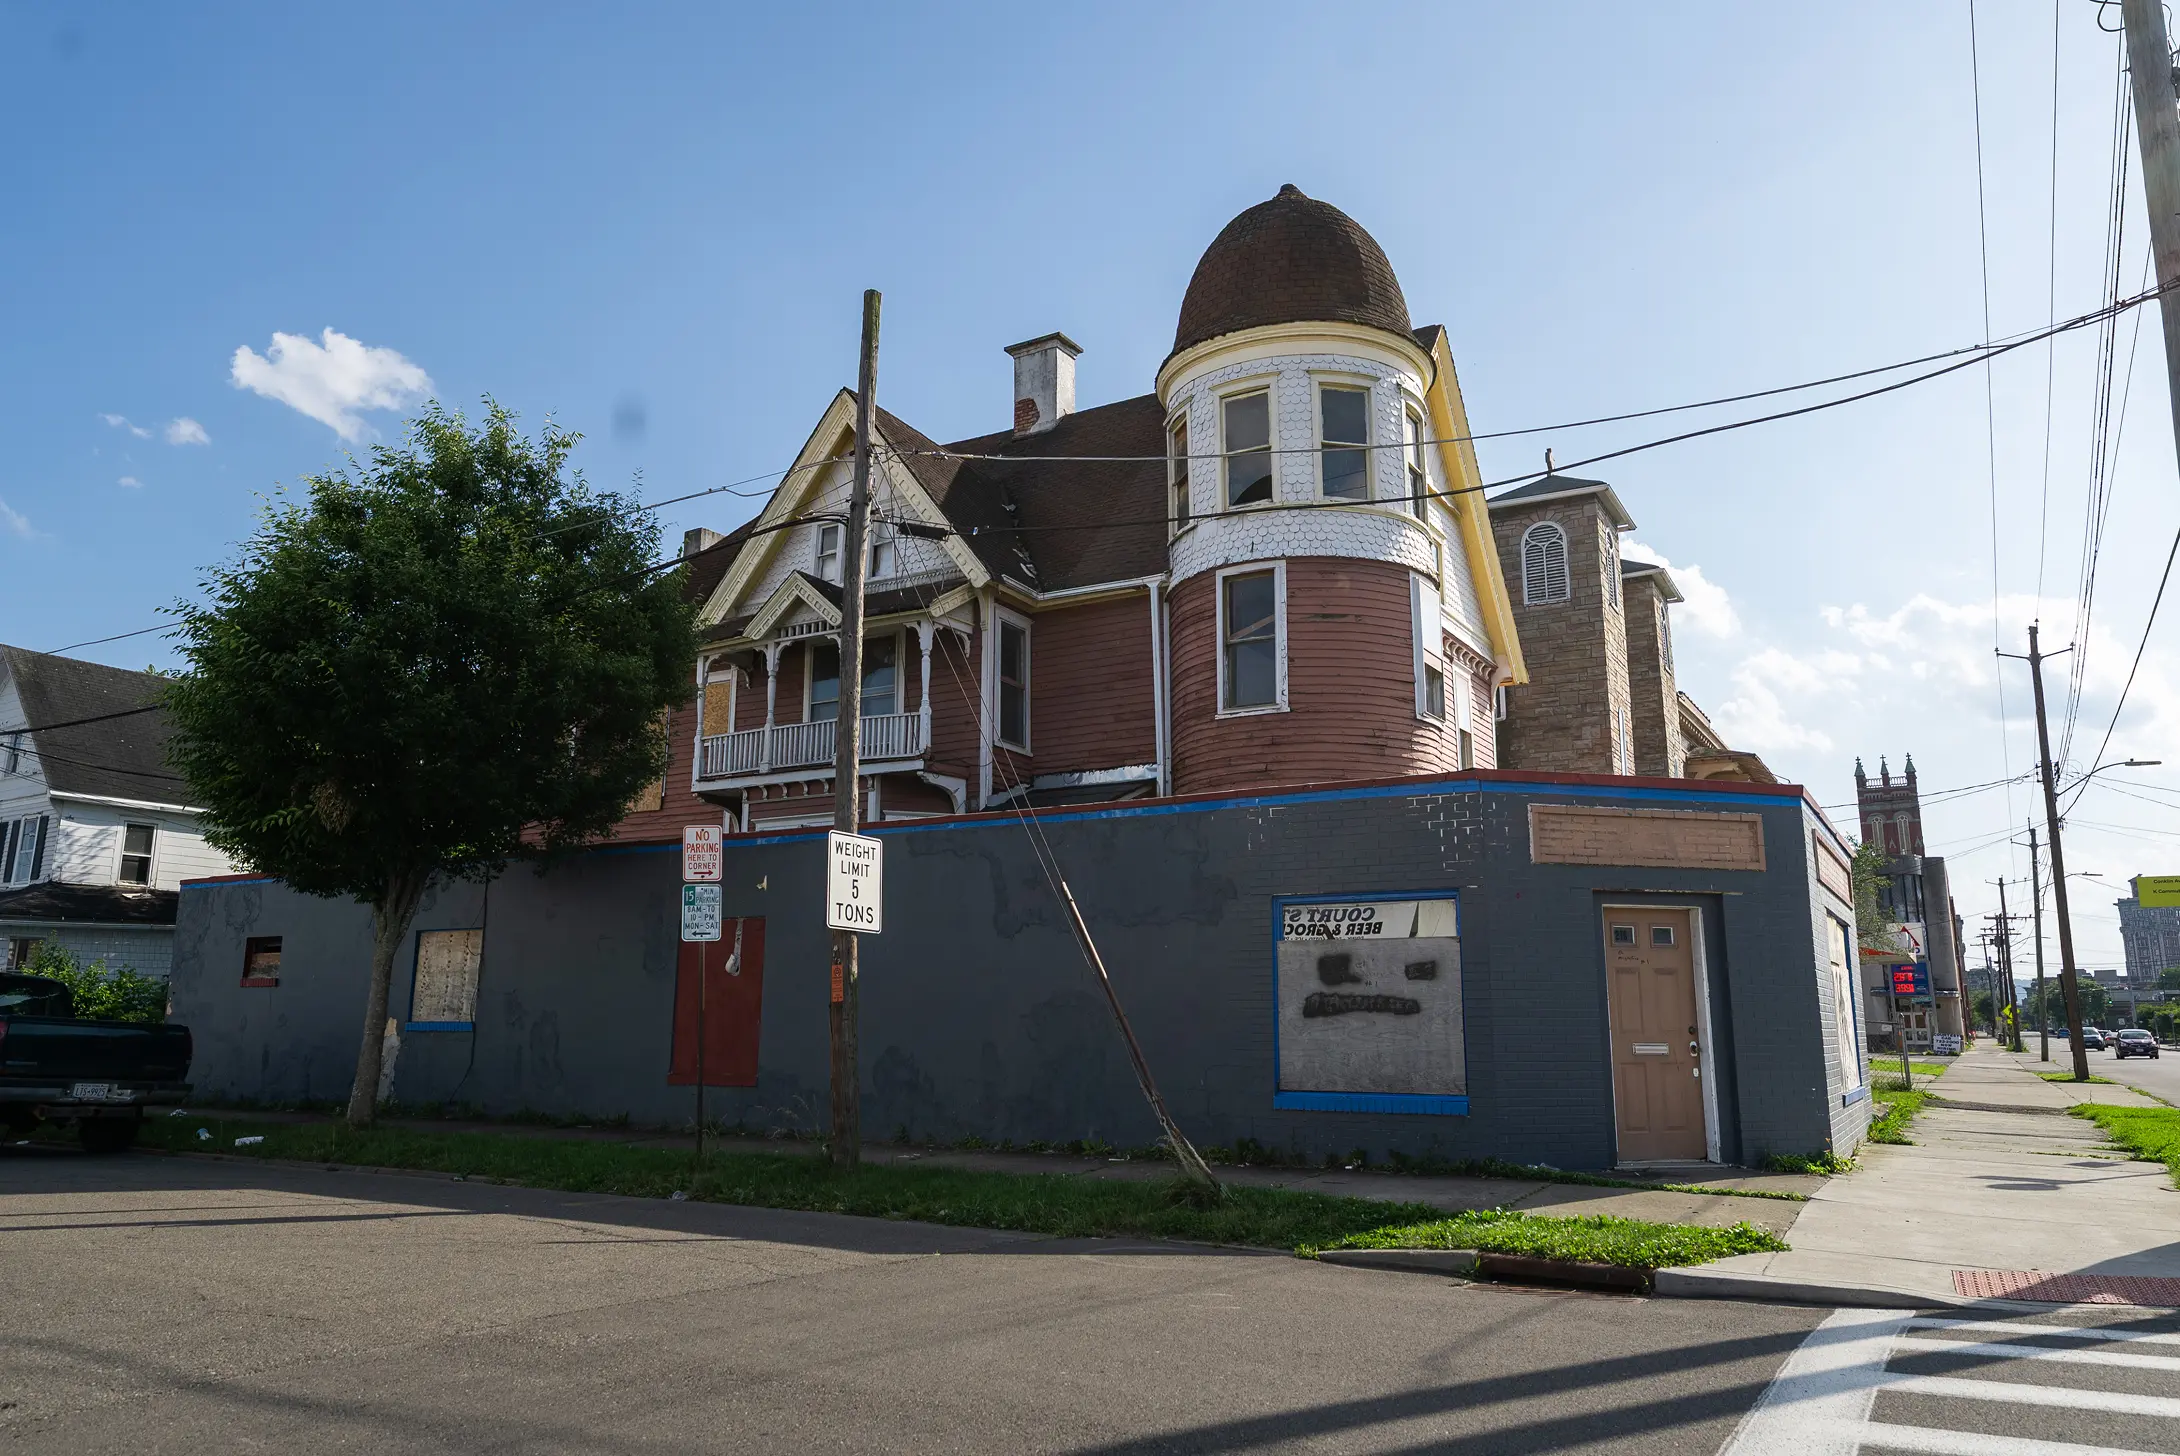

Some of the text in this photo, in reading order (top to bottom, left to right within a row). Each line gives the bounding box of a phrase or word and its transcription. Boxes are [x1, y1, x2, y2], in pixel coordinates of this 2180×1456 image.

[695, 830, 710, 841] NO
[686, 842, 719, 853] PARKING
[835, 840, 877, 860] WEIGHT
[687, 853, 717, 862] HERE TO
[688, 862, 717, 870] CORNER
[841, 860, 870, 878] LIMIT
[852, 879, 859, 899] 5
[685, 890, 695, 902] 15
[836, 902, 874, 924] TONS
